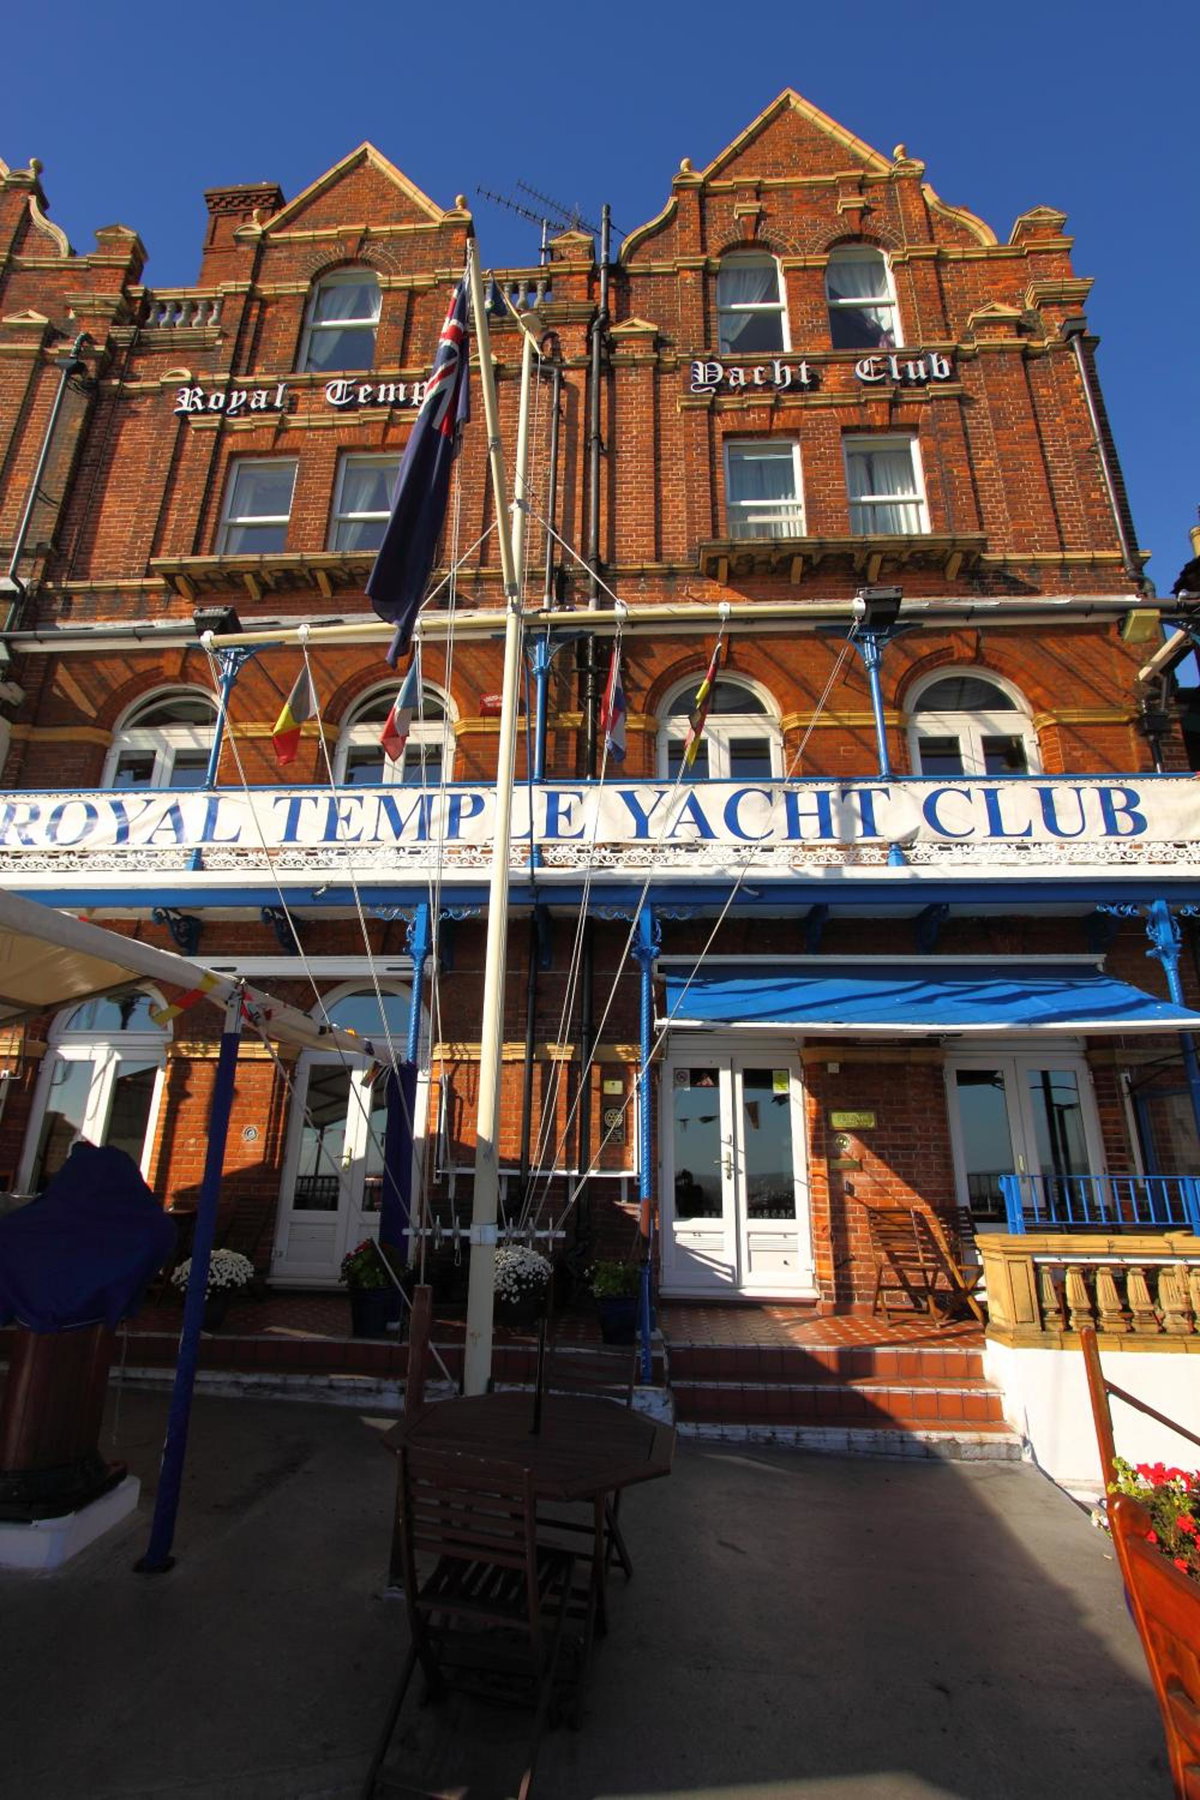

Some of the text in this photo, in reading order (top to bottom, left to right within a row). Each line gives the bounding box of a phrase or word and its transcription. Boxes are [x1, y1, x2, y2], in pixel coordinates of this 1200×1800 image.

[174, 352, 951, 415] Royal Temp Yacht Club
[0, 795, 243, 847] ROYAL
[615, 788, 891, 841] YACHT
[922, 785, 1148, 838] CLUB
